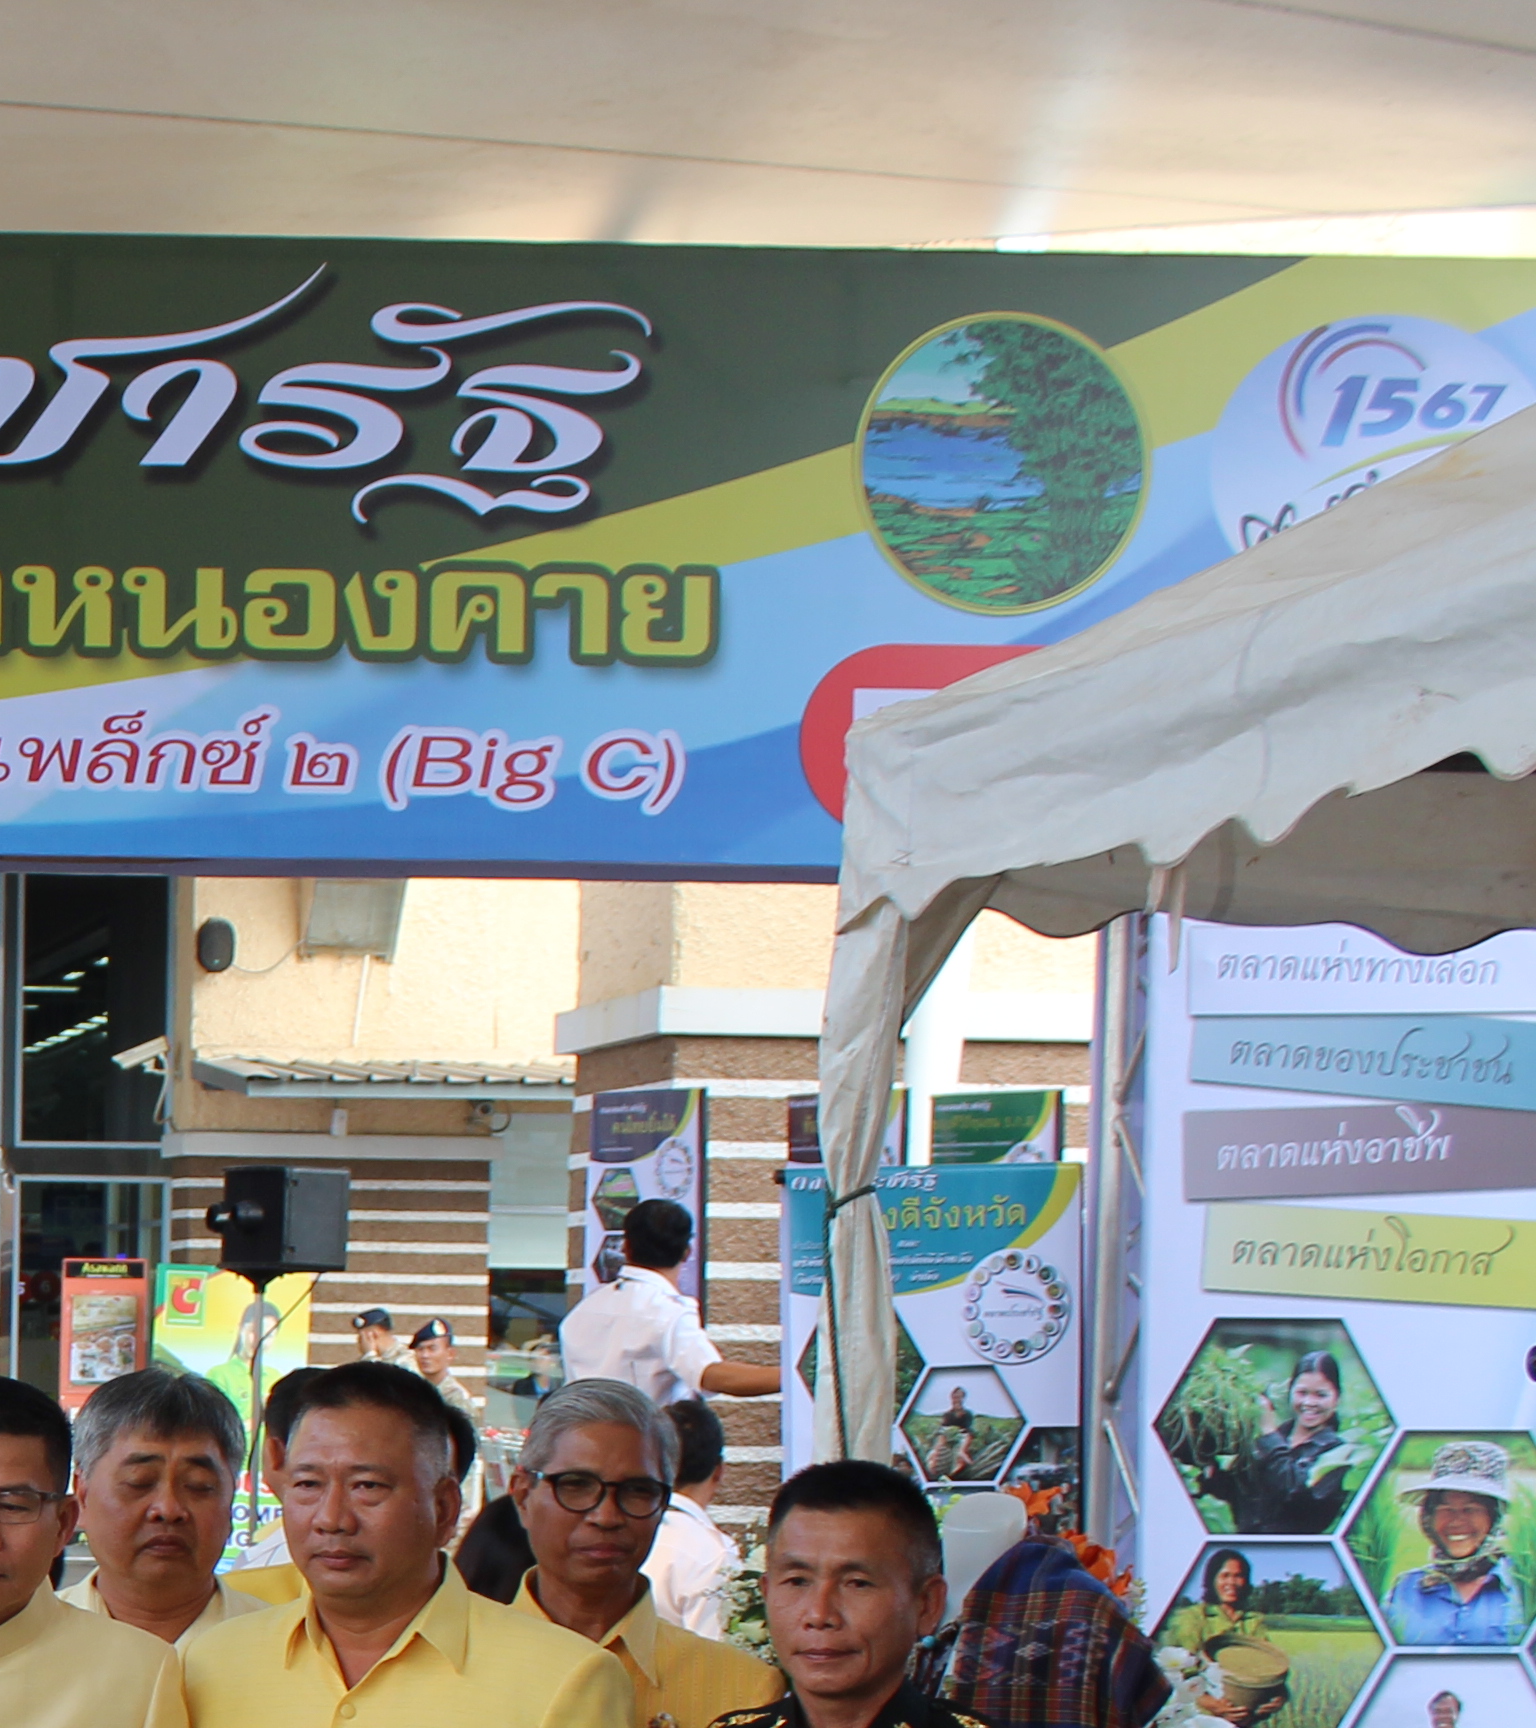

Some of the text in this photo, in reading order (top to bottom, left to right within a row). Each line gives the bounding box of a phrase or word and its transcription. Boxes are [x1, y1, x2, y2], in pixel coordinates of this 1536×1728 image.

[1320, 374, 1508, 448] 1567
[285, 738, 356, 791] ๒
[382, 730, 554, 807] (Big
[584, 732, 684, 812] C)
[1230, 1026, 1514, 1085] ตลาดของประชาชน
[1216, 1105, 1454, 1171] ตลาดแห่งอาชีพ
[882, 1195, 1027, 1232] งดีจังหวัด
[1232, 1215, 1515, 1276] ตลาดแห่งโอกาส
